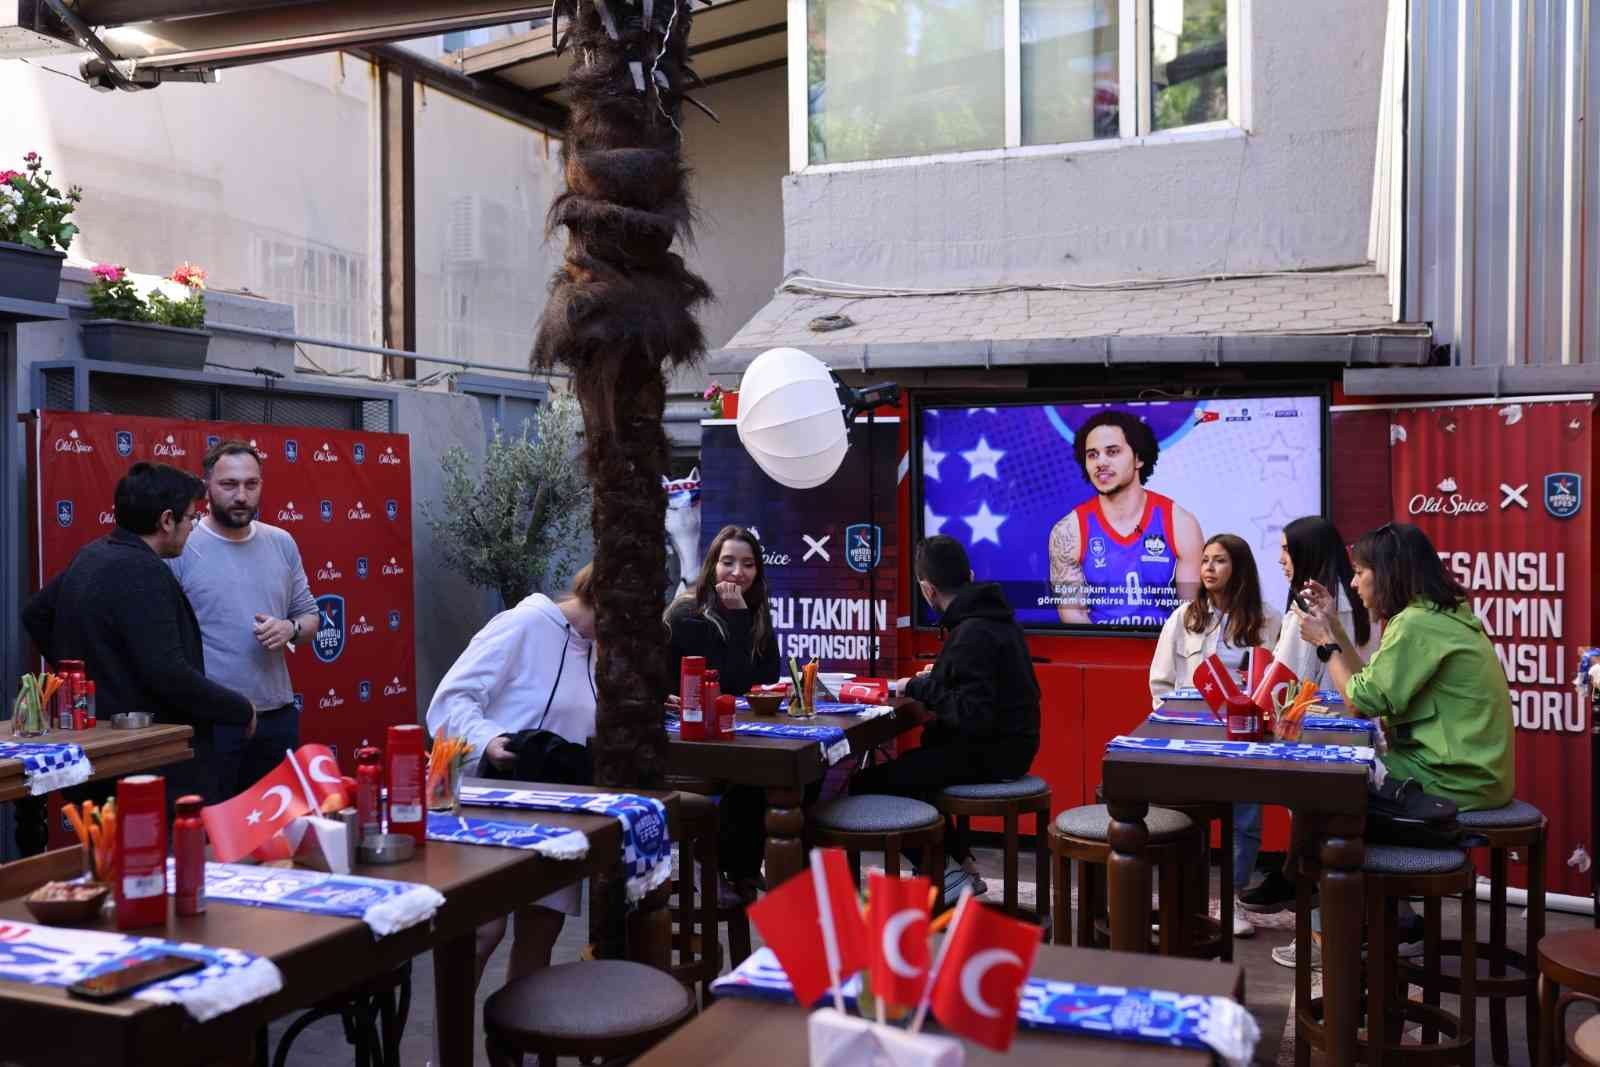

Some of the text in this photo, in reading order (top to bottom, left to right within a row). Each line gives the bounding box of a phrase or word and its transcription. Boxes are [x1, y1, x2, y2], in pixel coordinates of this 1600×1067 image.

[55, 438, 94, 453] Old Spice
[153, 443, 186, 457] Old Spice
[1408, 494, 1444, 515] Old
[1442, 494, 1488, 516] Spice
[799, 598, 887, 631] TAKIMIN
[1473, 597, 1563, 638] KIMIN
[320, 637, 338, 648] EFES
[1494, 643, 1565, 685] NSLI
[1509, 689, 1585, 733] SORU
